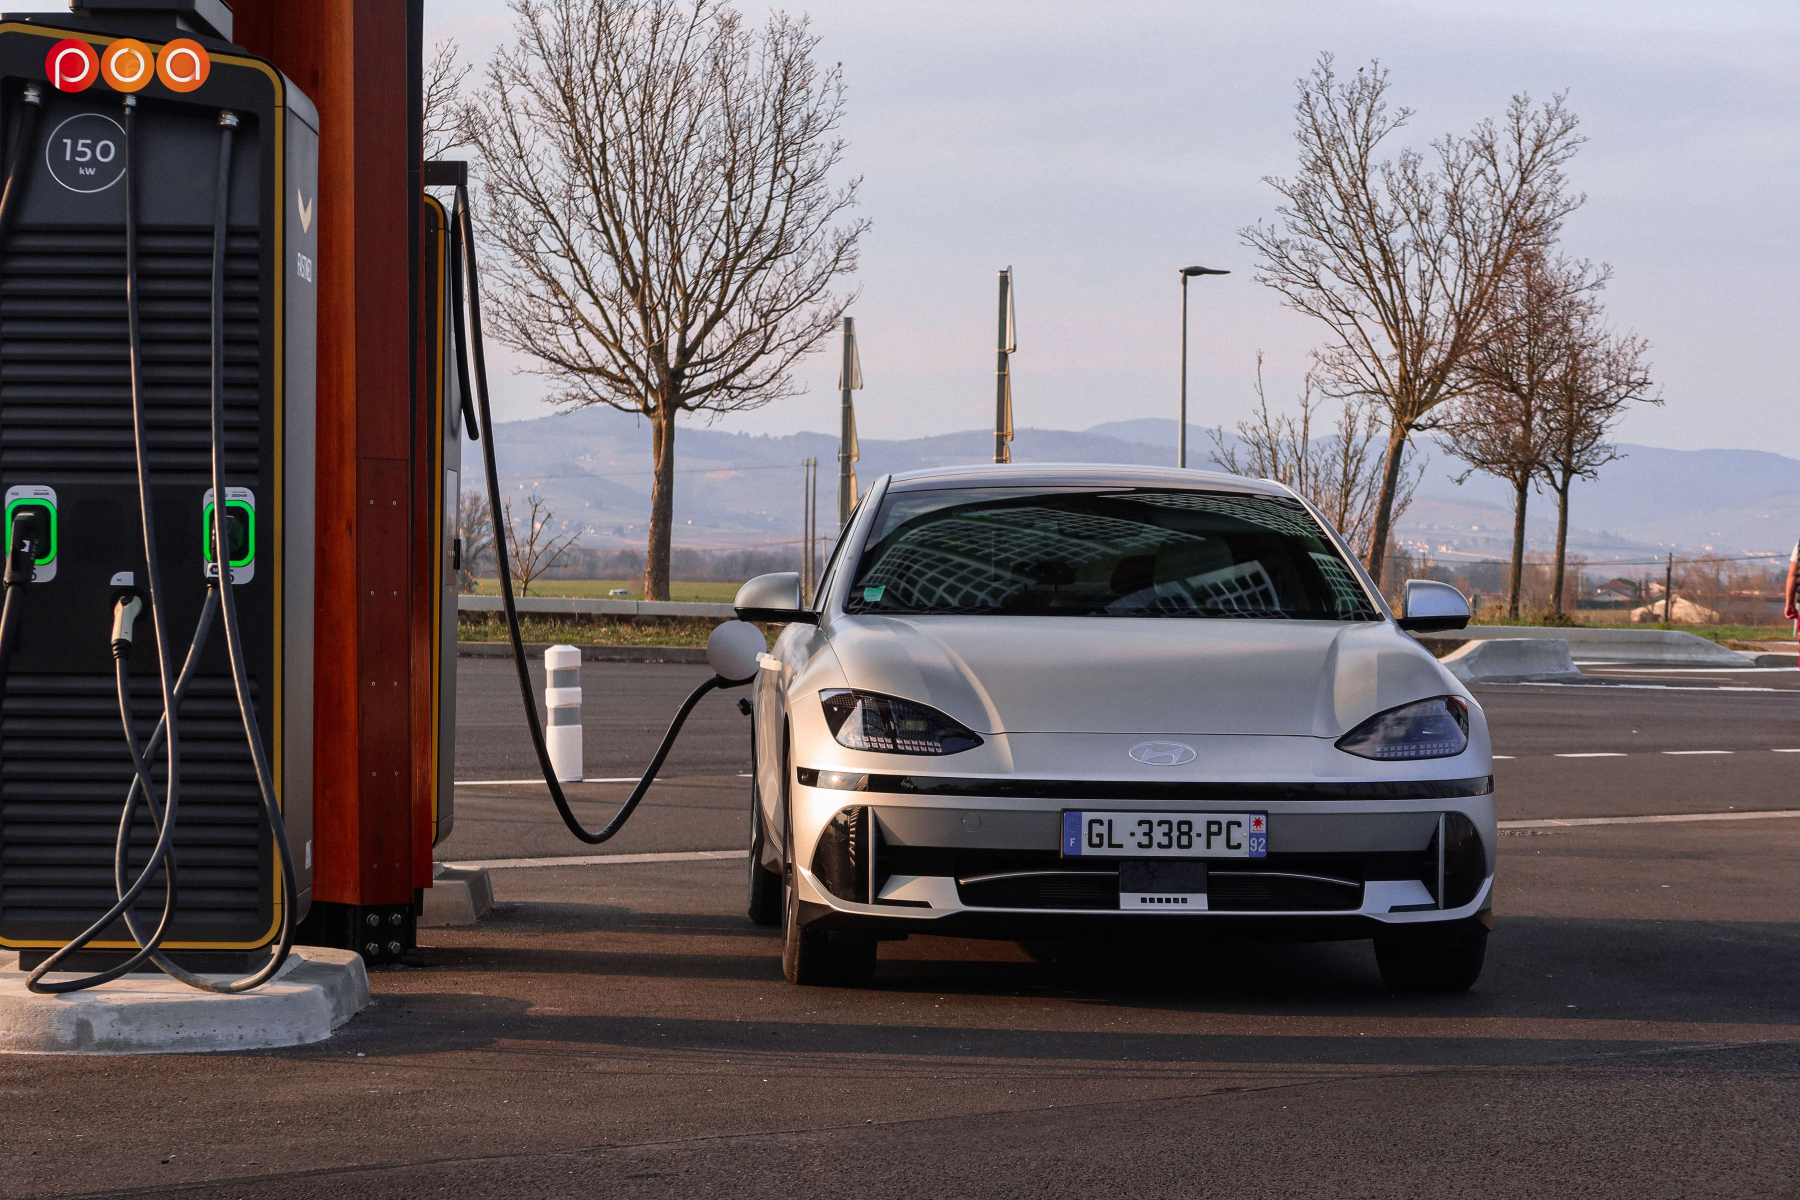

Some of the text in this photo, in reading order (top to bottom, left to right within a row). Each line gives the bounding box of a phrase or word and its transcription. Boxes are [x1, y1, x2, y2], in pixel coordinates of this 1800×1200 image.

[62, 138, 116, 163] 150
[79, 166, 96, 176] kW
[1069, 837, 1076, 847] F
[1087, 818, 1242, 850] GL-338-PC
[1249, 837, 1266, 853] 92
